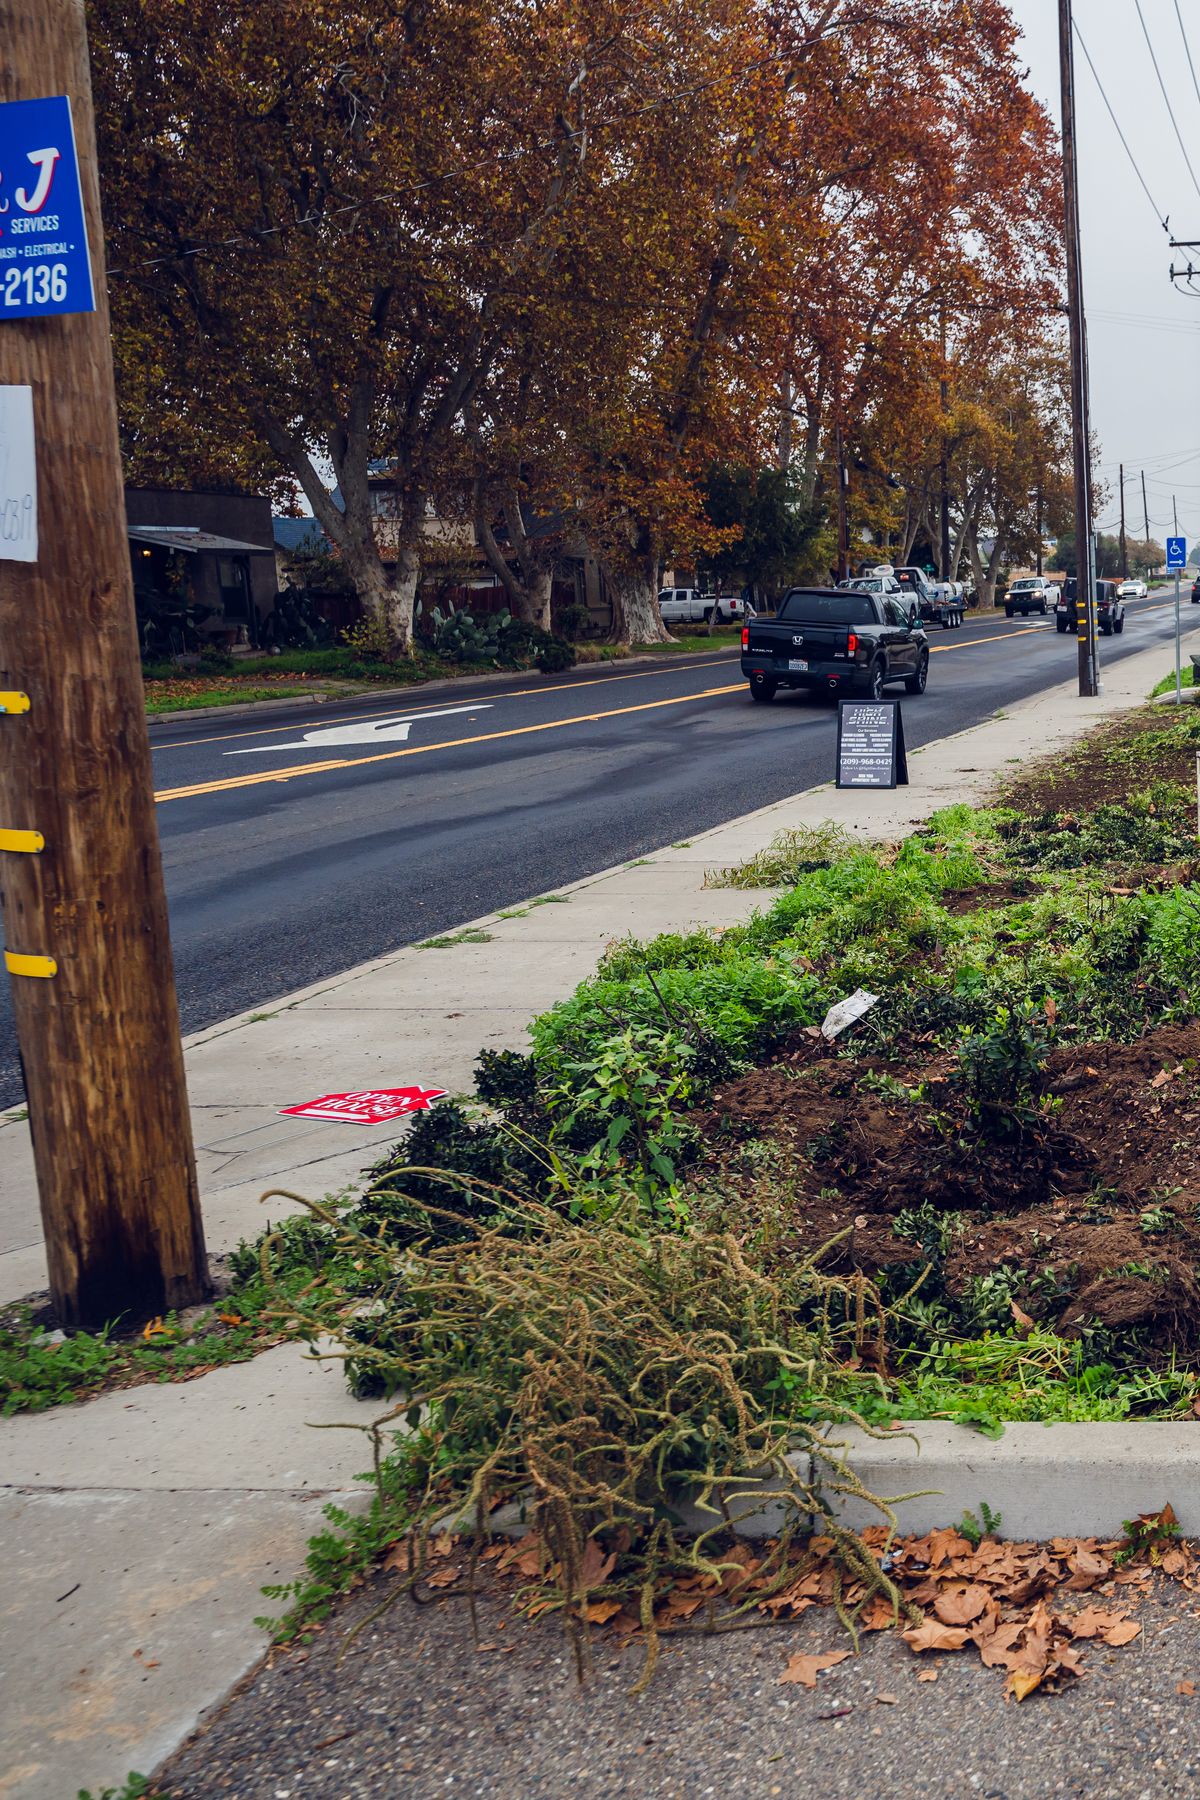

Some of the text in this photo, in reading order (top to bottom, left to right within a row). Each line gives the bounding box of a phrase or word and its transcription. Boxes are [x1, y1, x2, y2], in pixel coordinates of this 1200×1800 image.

[15, 147, 61, 213] J
[11, 215, 59, 234] SERVICES
[0, 242, 69, 259] ASH ELECTRICAL
[312, 1099, 408, 1116] HOUSE
[345, 1092, 421, 1106] OPEN
